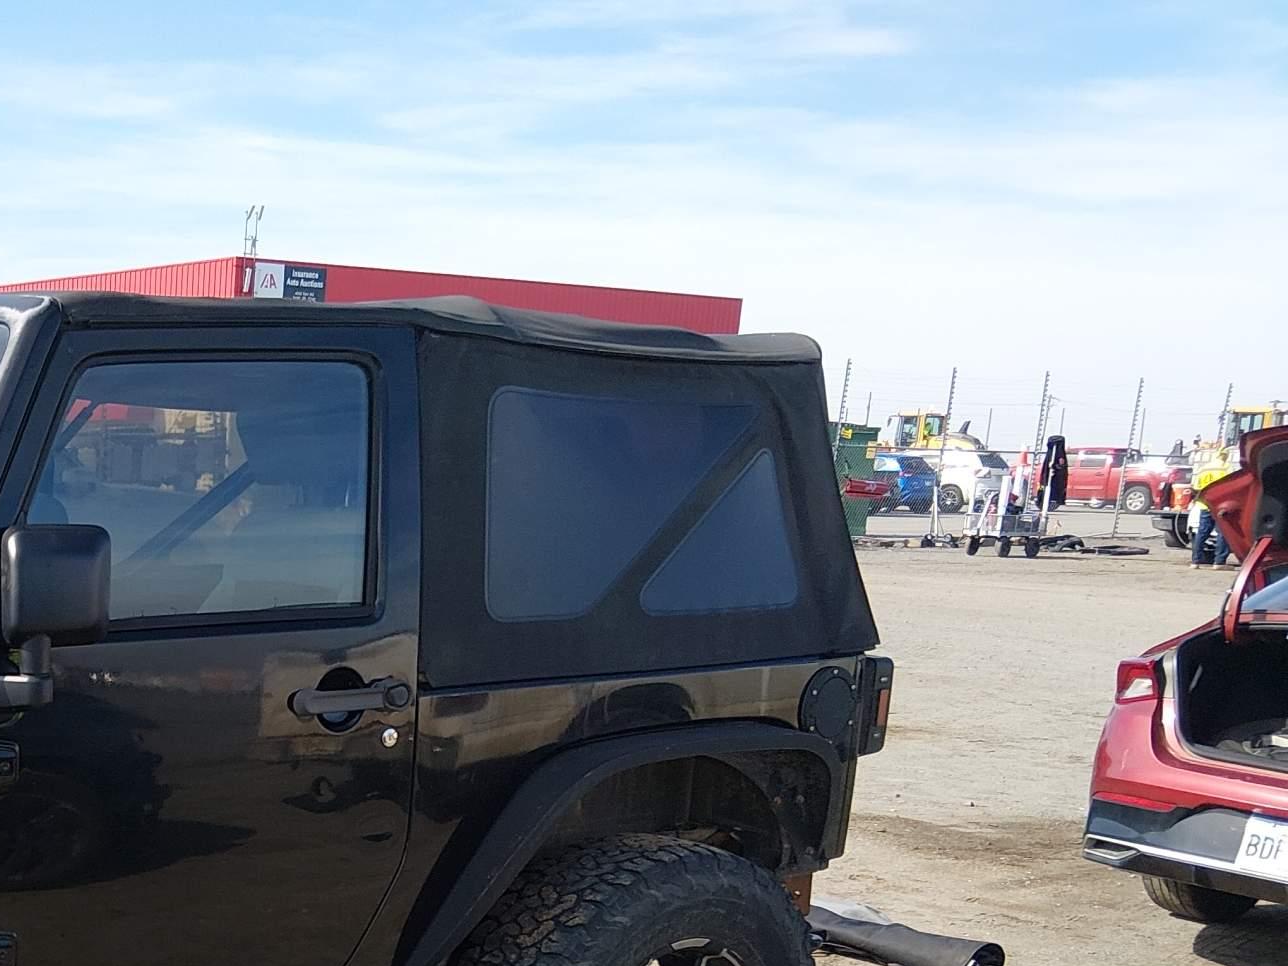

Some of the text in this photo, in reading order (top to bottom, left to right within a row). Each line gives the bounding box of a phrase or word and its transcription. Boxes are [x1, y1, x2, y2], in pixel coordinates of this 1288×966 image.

[292, 269, 319, 279] Insurance
[286, 278, 323, 289] Auto Auctions
